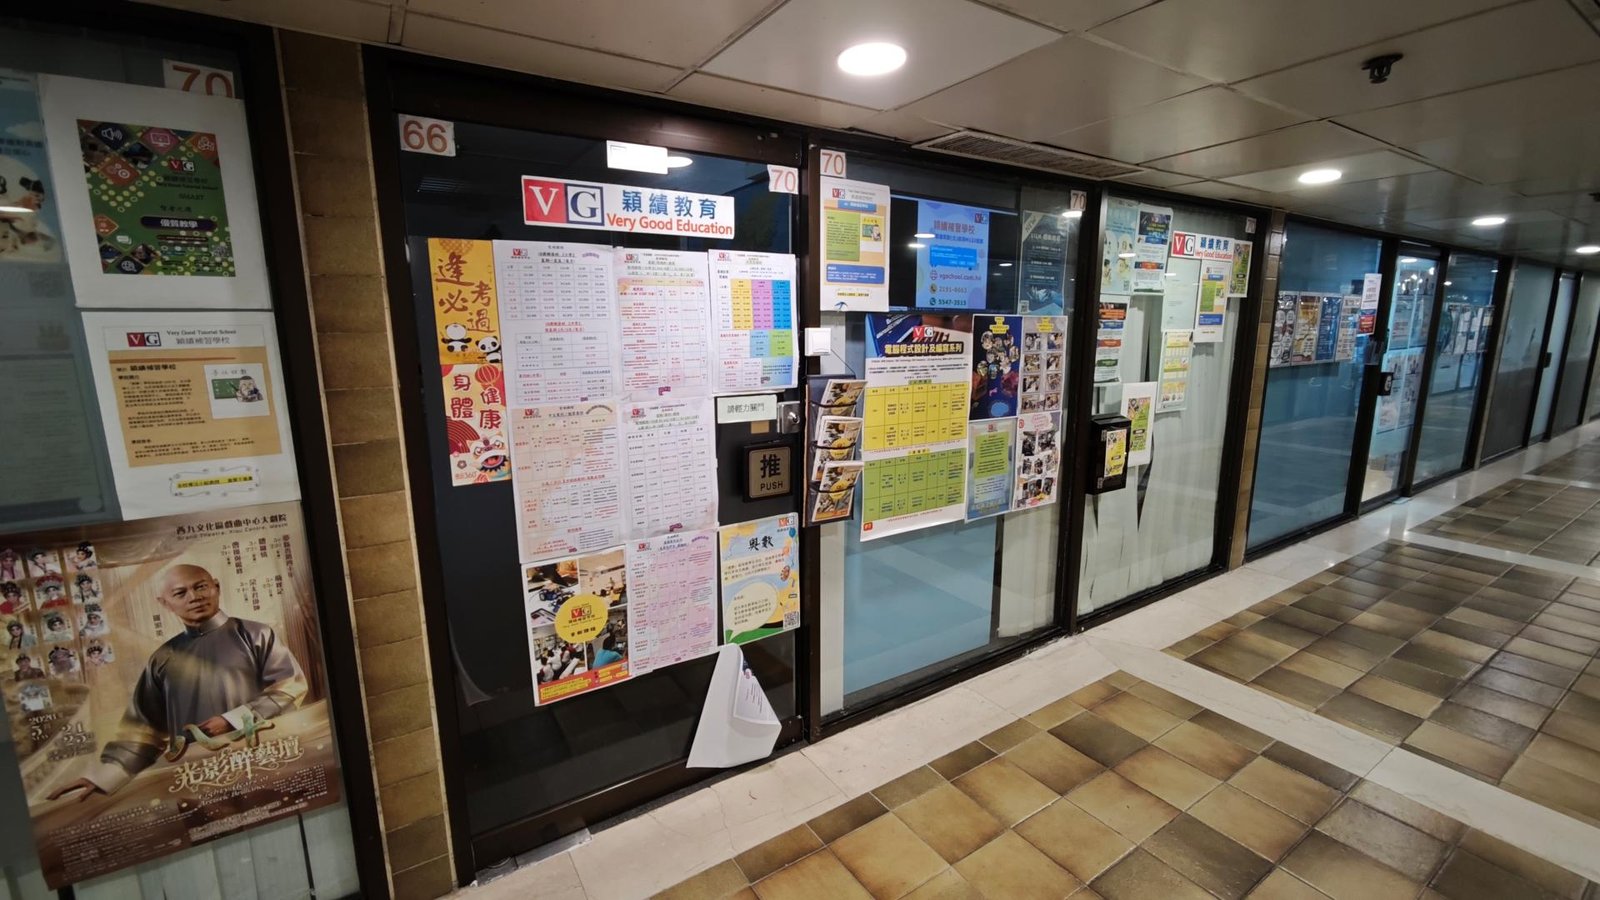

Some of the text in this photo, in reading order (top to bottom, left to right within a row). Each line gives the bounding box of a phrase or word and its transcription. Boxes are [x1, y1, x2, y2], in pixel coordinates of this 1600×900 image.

[403, 119, 448, 153] 66
[821, 152, 845, 175] 70
[771, 169, 797, 190] 70
[622, 189, 717, 220] 穎績教育
[1072, 192, 1086, 210] 70
[607, 213, 733, 235] Very Good Education
[1204, 250, 1215, 258] Good
[128, 334, 159, 345] VG
[914, 327, 934, 338] VG
[760, 454, 781, 479] 推
[760, 482, 784, 491] PUSH
[748, 535, 774, 551] 奧數
